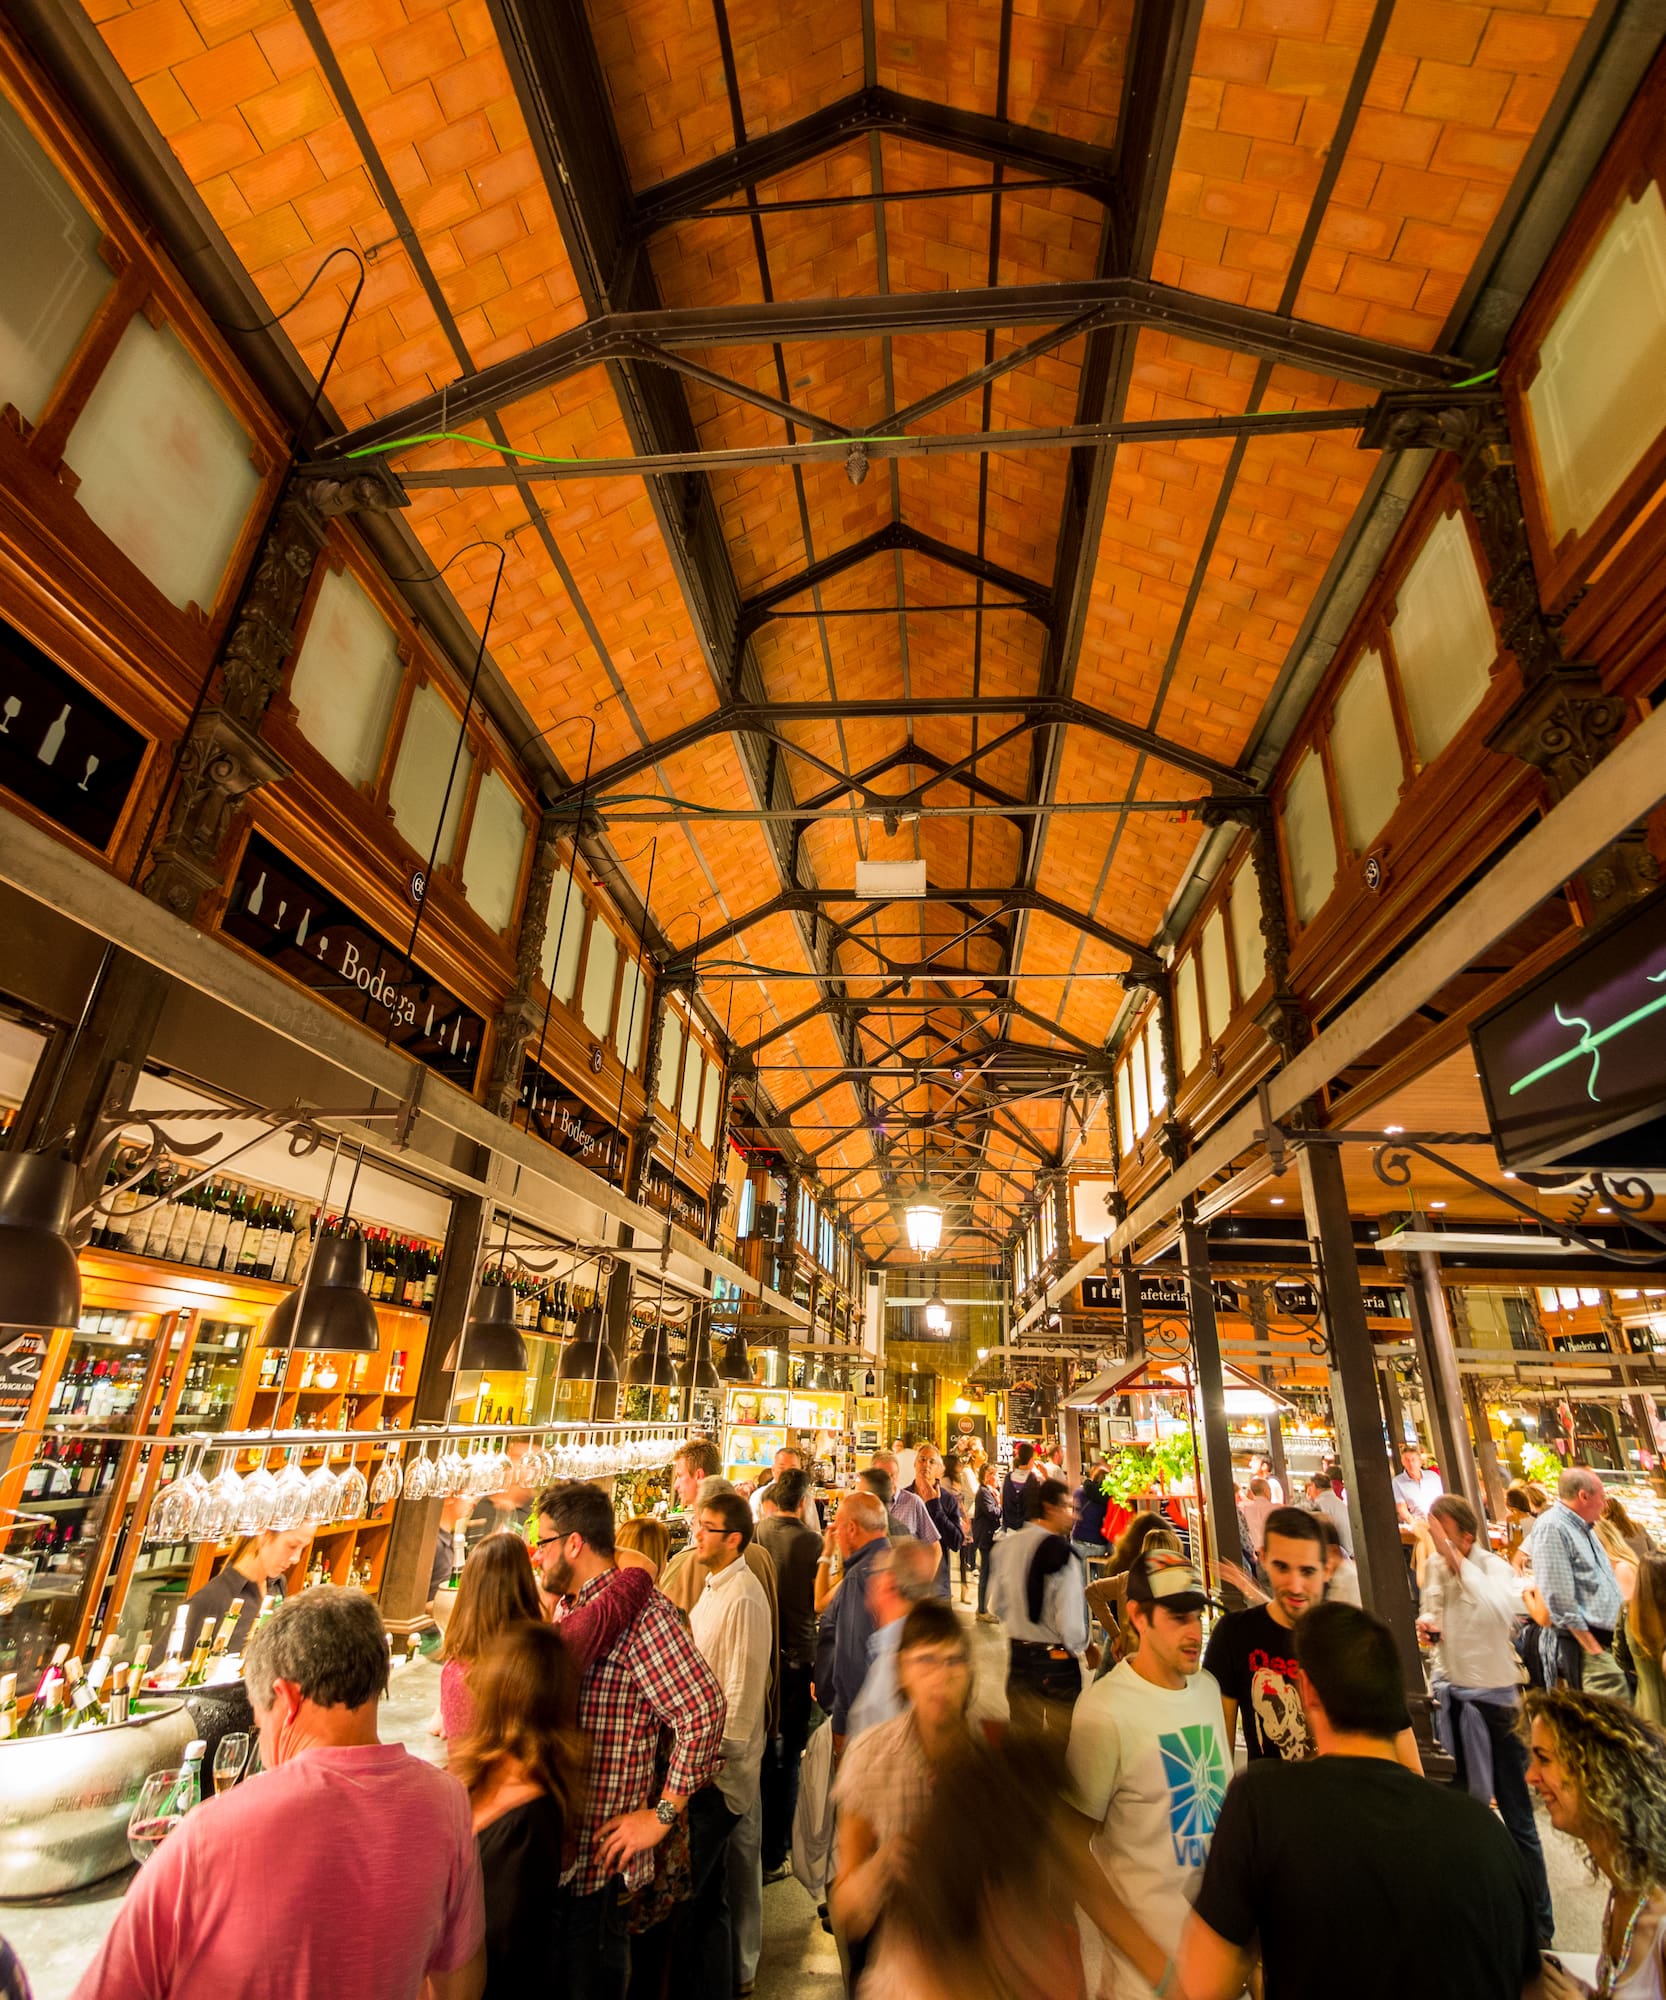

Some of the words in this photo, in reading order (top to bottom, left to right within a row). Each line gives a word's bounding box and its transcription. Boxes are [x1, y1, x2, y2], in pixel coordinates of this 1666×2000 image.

[338, 940, 416, 1027] Bodega
[560, 1107, 595, 1157] Bodega
[1140, 1288, 1187, 1302] afetería
[1249, 1648, 1300, 1680] Dea
